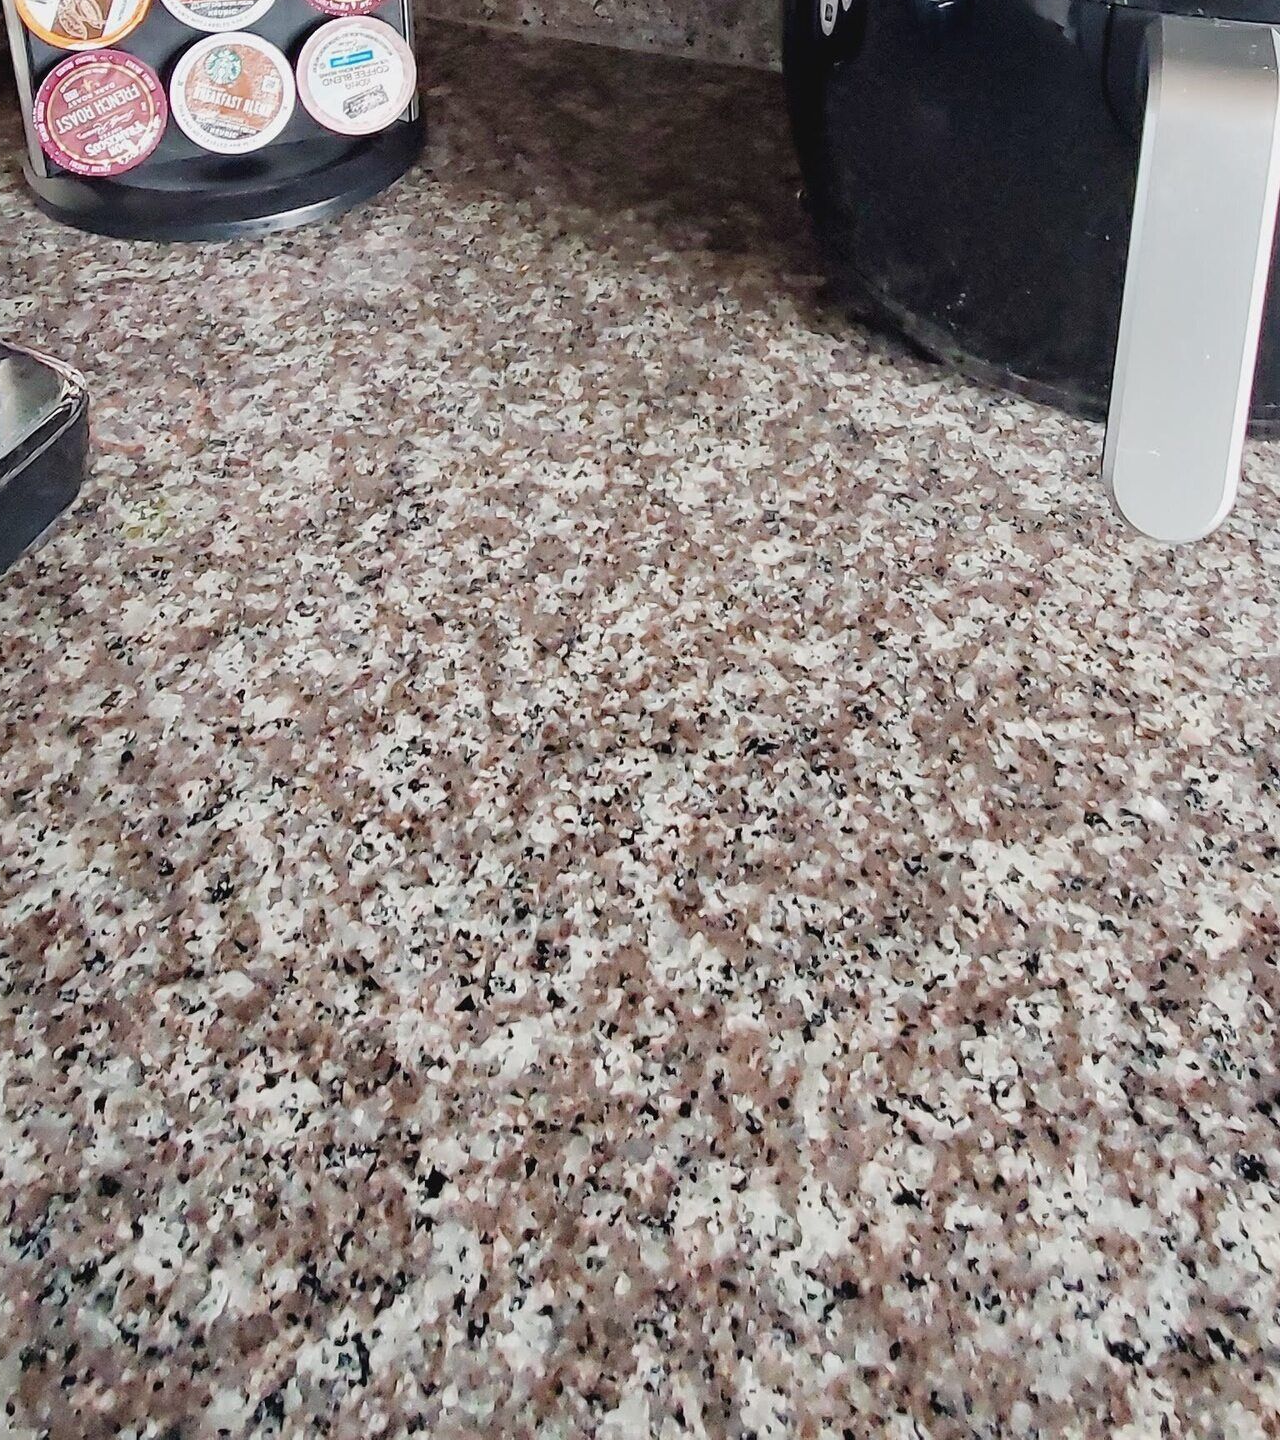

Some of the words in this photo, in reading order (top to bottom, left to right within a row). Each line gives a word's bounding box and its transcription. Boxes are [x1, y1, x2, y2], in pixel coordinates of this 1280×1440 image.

[322, 74, 352, 86] BLEND
[355, 66, 389, 78] COFFEE
[95, 82, 116, 95] DARK
[193, 84, 243, 110] BREAKFAST
[68, 92, 93, 109] ROAST
[94, 83, 140, 116] FRENCH
[56, 106, 96, 134] ROAST
